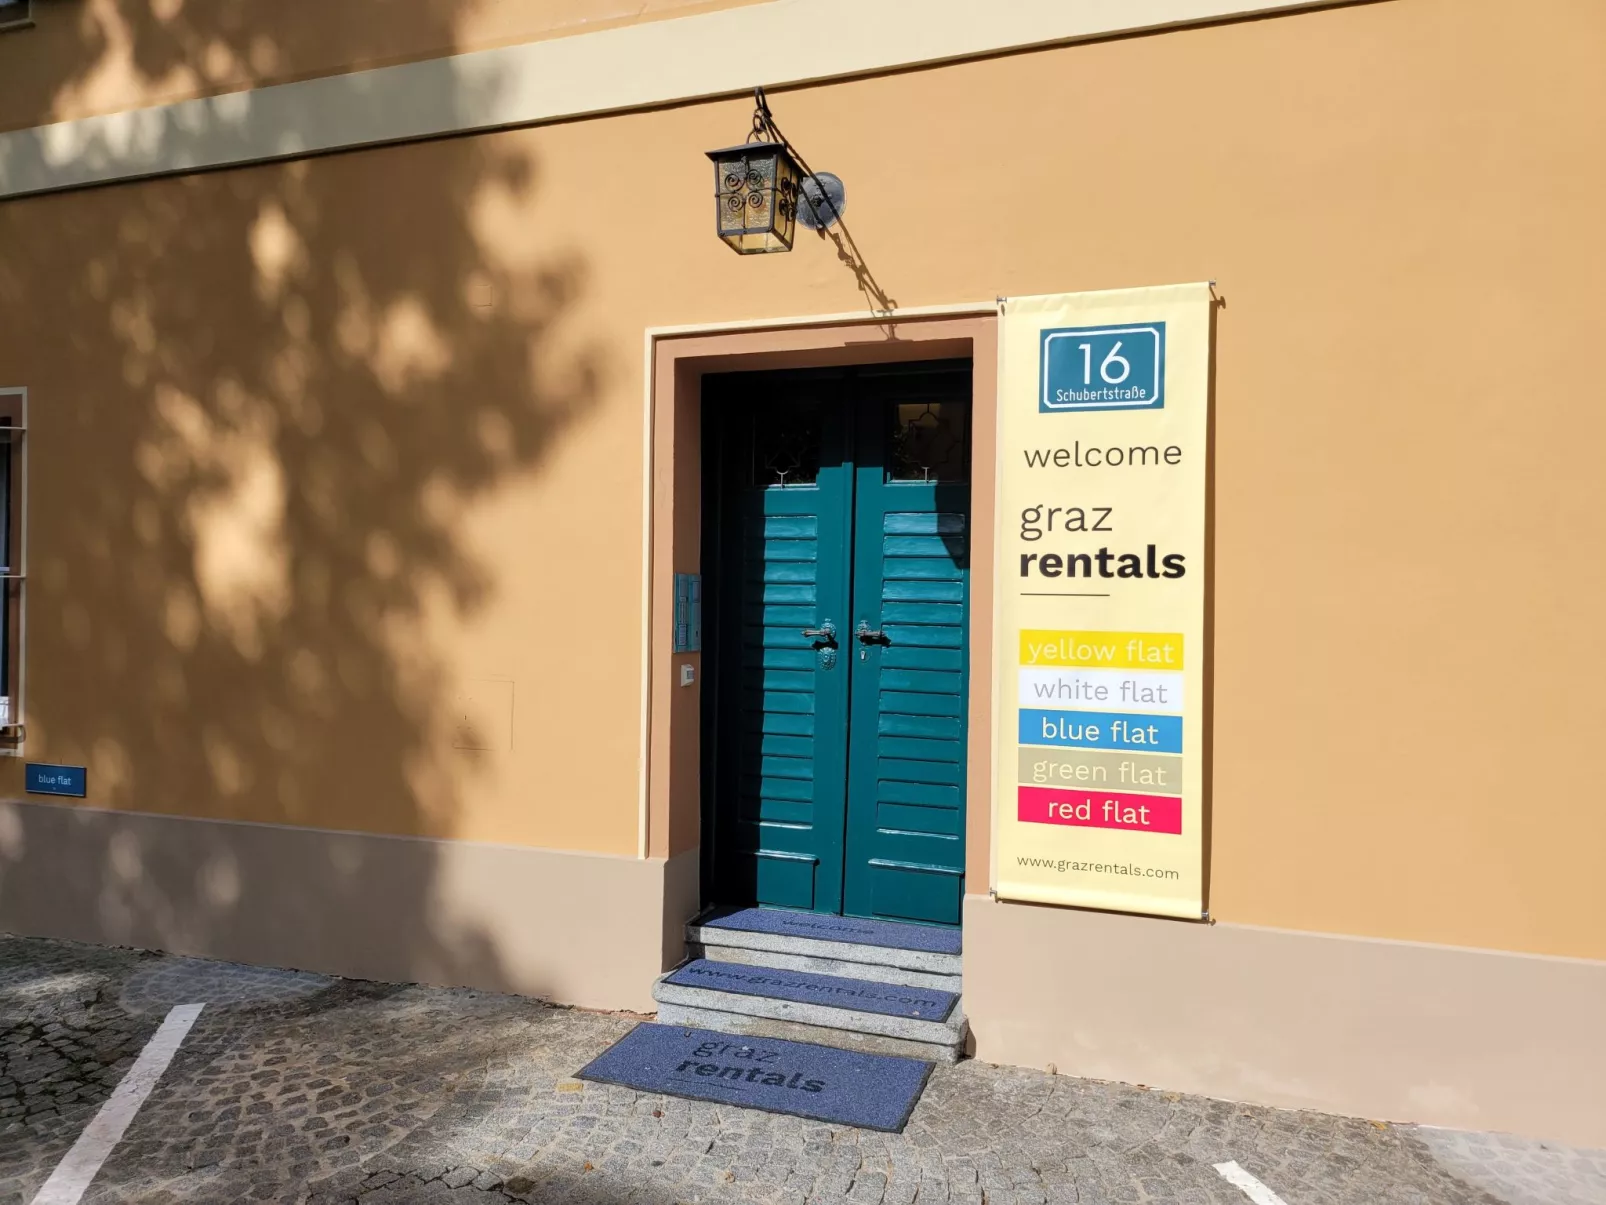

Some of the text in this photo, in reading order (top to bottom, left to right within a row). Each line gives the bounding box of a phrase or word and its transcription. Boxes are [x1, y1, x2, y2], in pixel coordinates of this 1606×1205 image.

[1078, 341, 1130, 385] 16
[1056, 386, 1146, 402] Schubertstraße
[1024, 441, 1182, 468] welcome
[1020, 504, 1113, 541] graz
[1020, 544, 1186, 579] rentals
[1028, 639, 1175, 664] yellow flat
[1034, 678, 1168, 704] white flat
[1042, 717, 1159, 745] blue flat
[38, 774, 71, 785] blue flat
[1033, 759, 1167, 786] green flat
[1048, 799, 1150, 825] red flat
[1017, 855, 1179, 880] www.grazrentals.com
[782, 920, 875, 934] welcome
[689, 965, 936, 1008] www.grazrentals.com
[692, 1040, 780, 1064] graz
[676, 1059, 827, 1093] rentals
